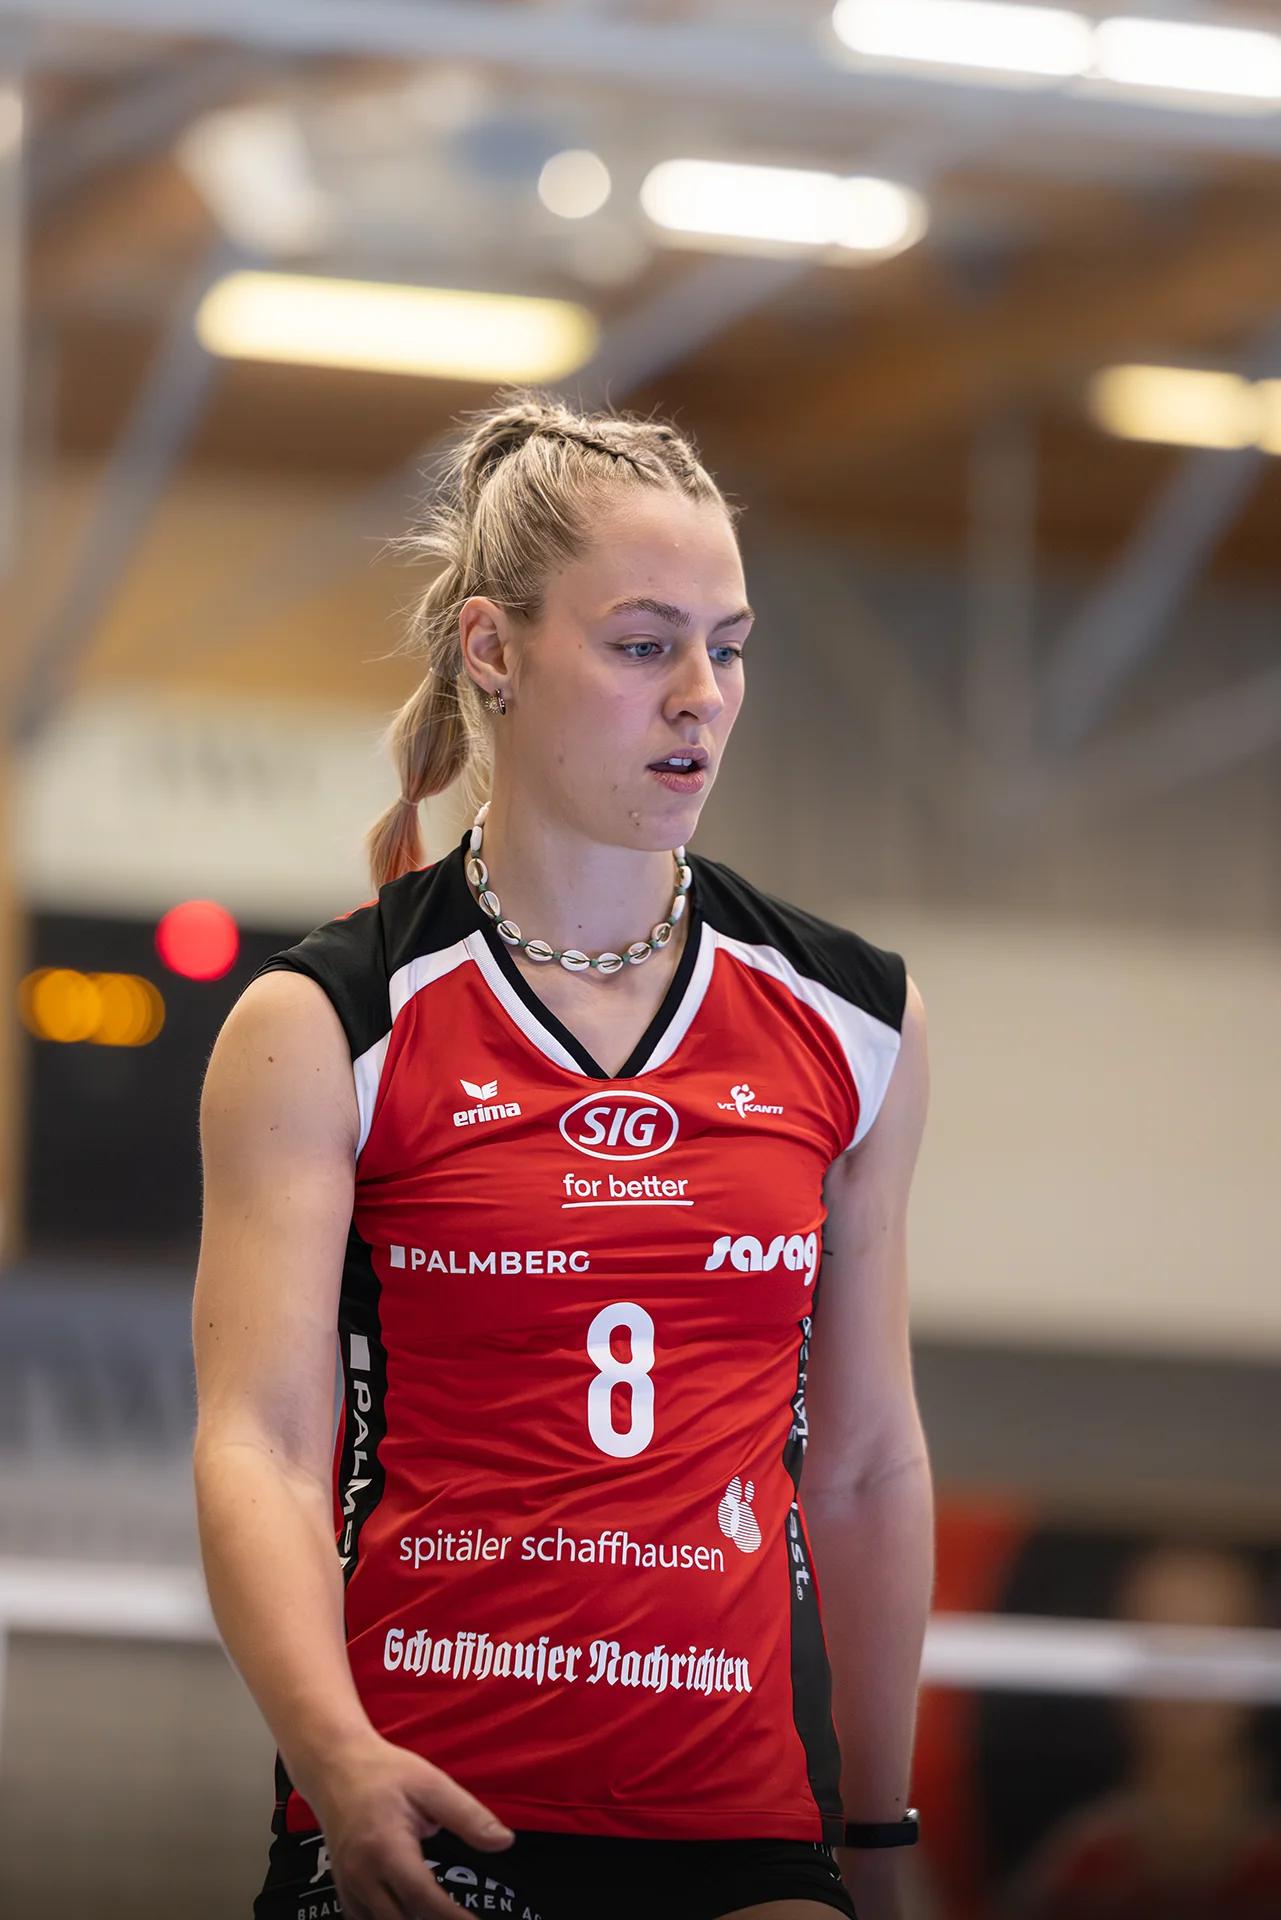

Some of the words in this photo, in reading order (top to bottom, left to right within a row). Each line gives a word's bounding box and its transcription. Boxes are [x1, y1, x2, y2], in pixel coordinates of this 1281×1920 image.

[453, 1102, 521, 1127] erima
[578, 1106, 659, 1147] SIG
[717, 1102, 736, 1111] VC
[744, 1103, 784, 1115] KANTI
[562, 1173, 601, 1198] for
[609, 1174, 689, 1199] better
[410, 1248, 591, 1275] PALMBERG
[704, 1231, 818, 1286] sasag
[586, 1302, 656, 1459] 8
[400, 1529, 512, 1569] spitäler
[520, 1528, 725, 1572] schaffhausen
[586, 1639, 753, 1696] Nachrichten
